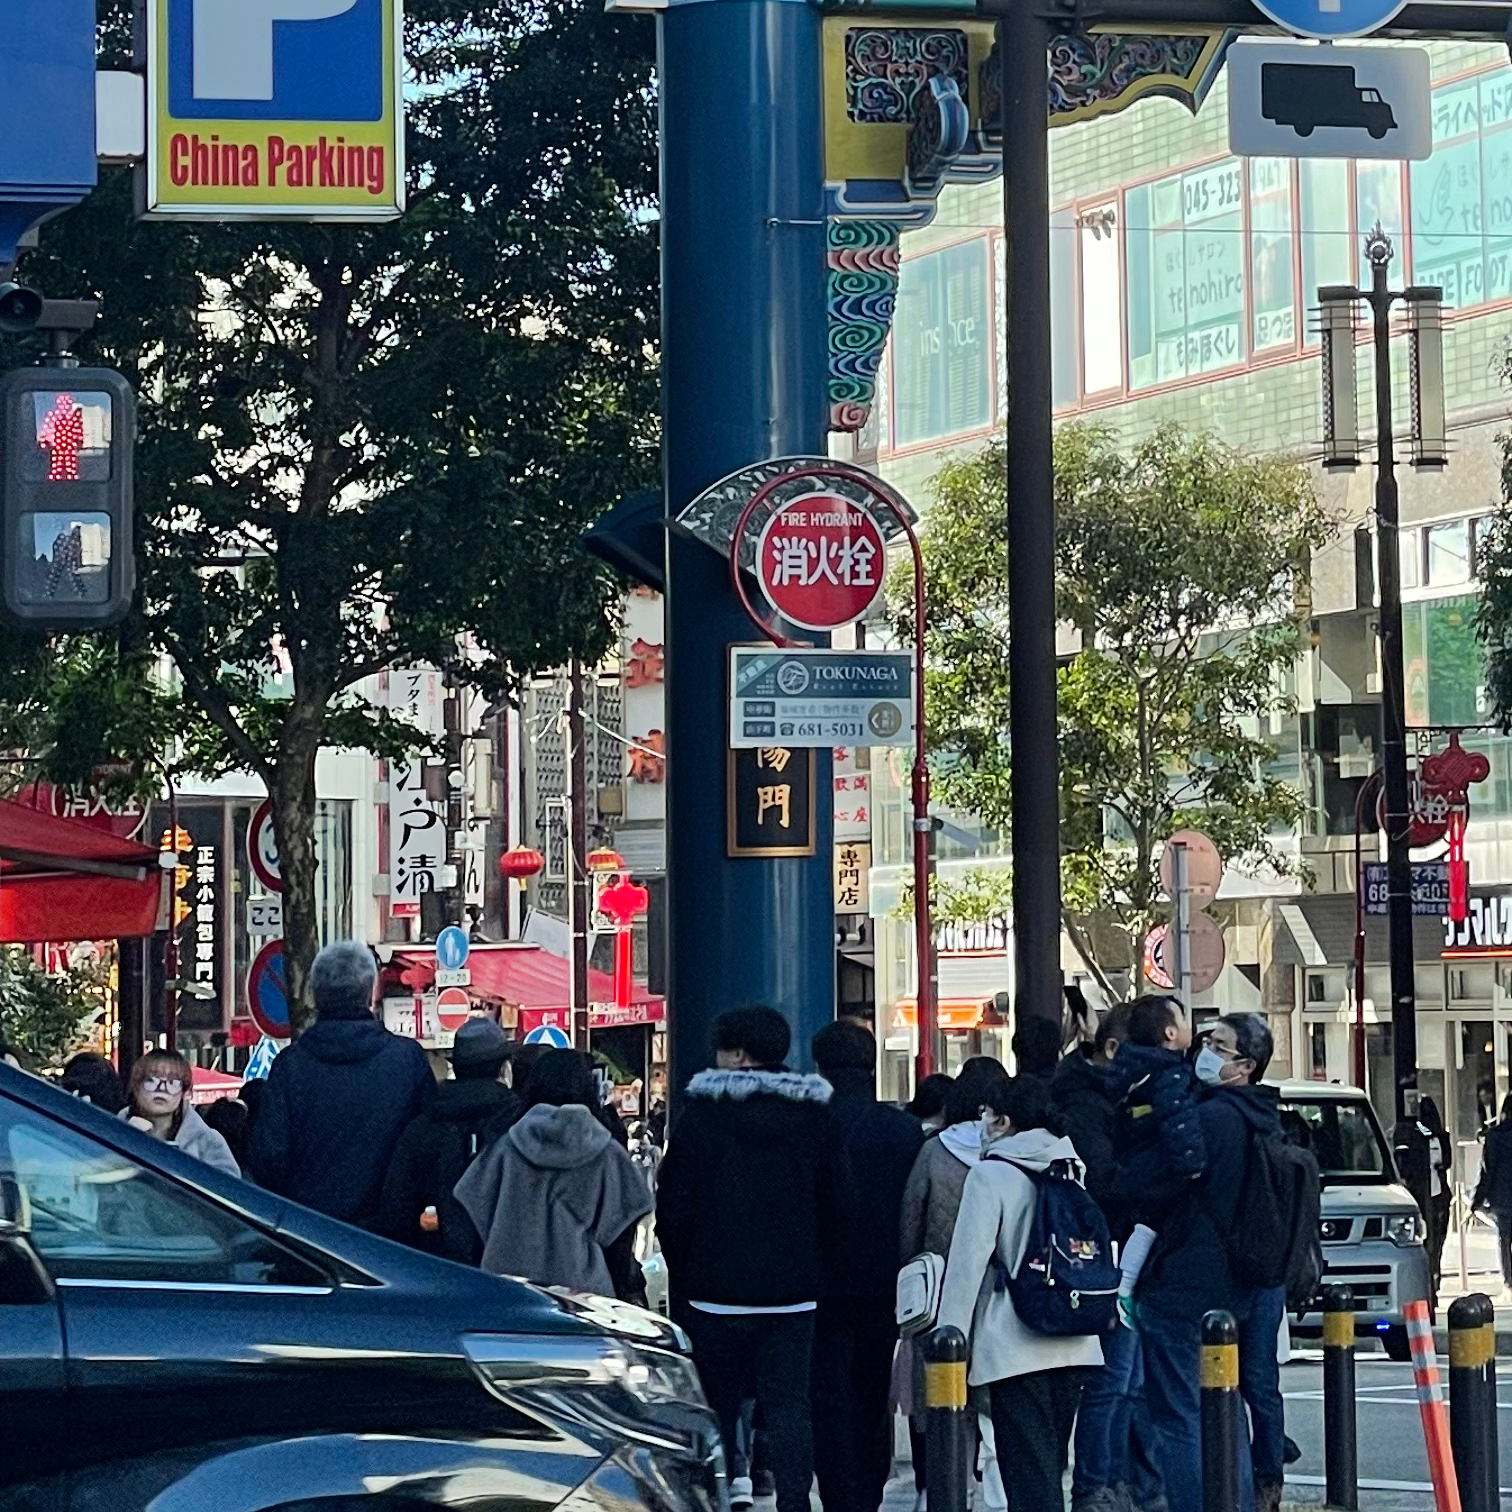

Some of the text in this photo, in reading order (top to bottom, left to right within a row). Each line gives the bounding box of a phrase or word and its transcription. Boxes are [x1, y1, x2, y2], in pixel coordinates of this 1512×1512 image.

[170, 133, 385, 195] China Parking
[781, 512, 864, 528] FIRE HYDRANT
[772, 536, 875, 587] 消火栓
[812, 665, 899, 681] TOKUNAGA
[798, 722, 864, 737] 681-5031
